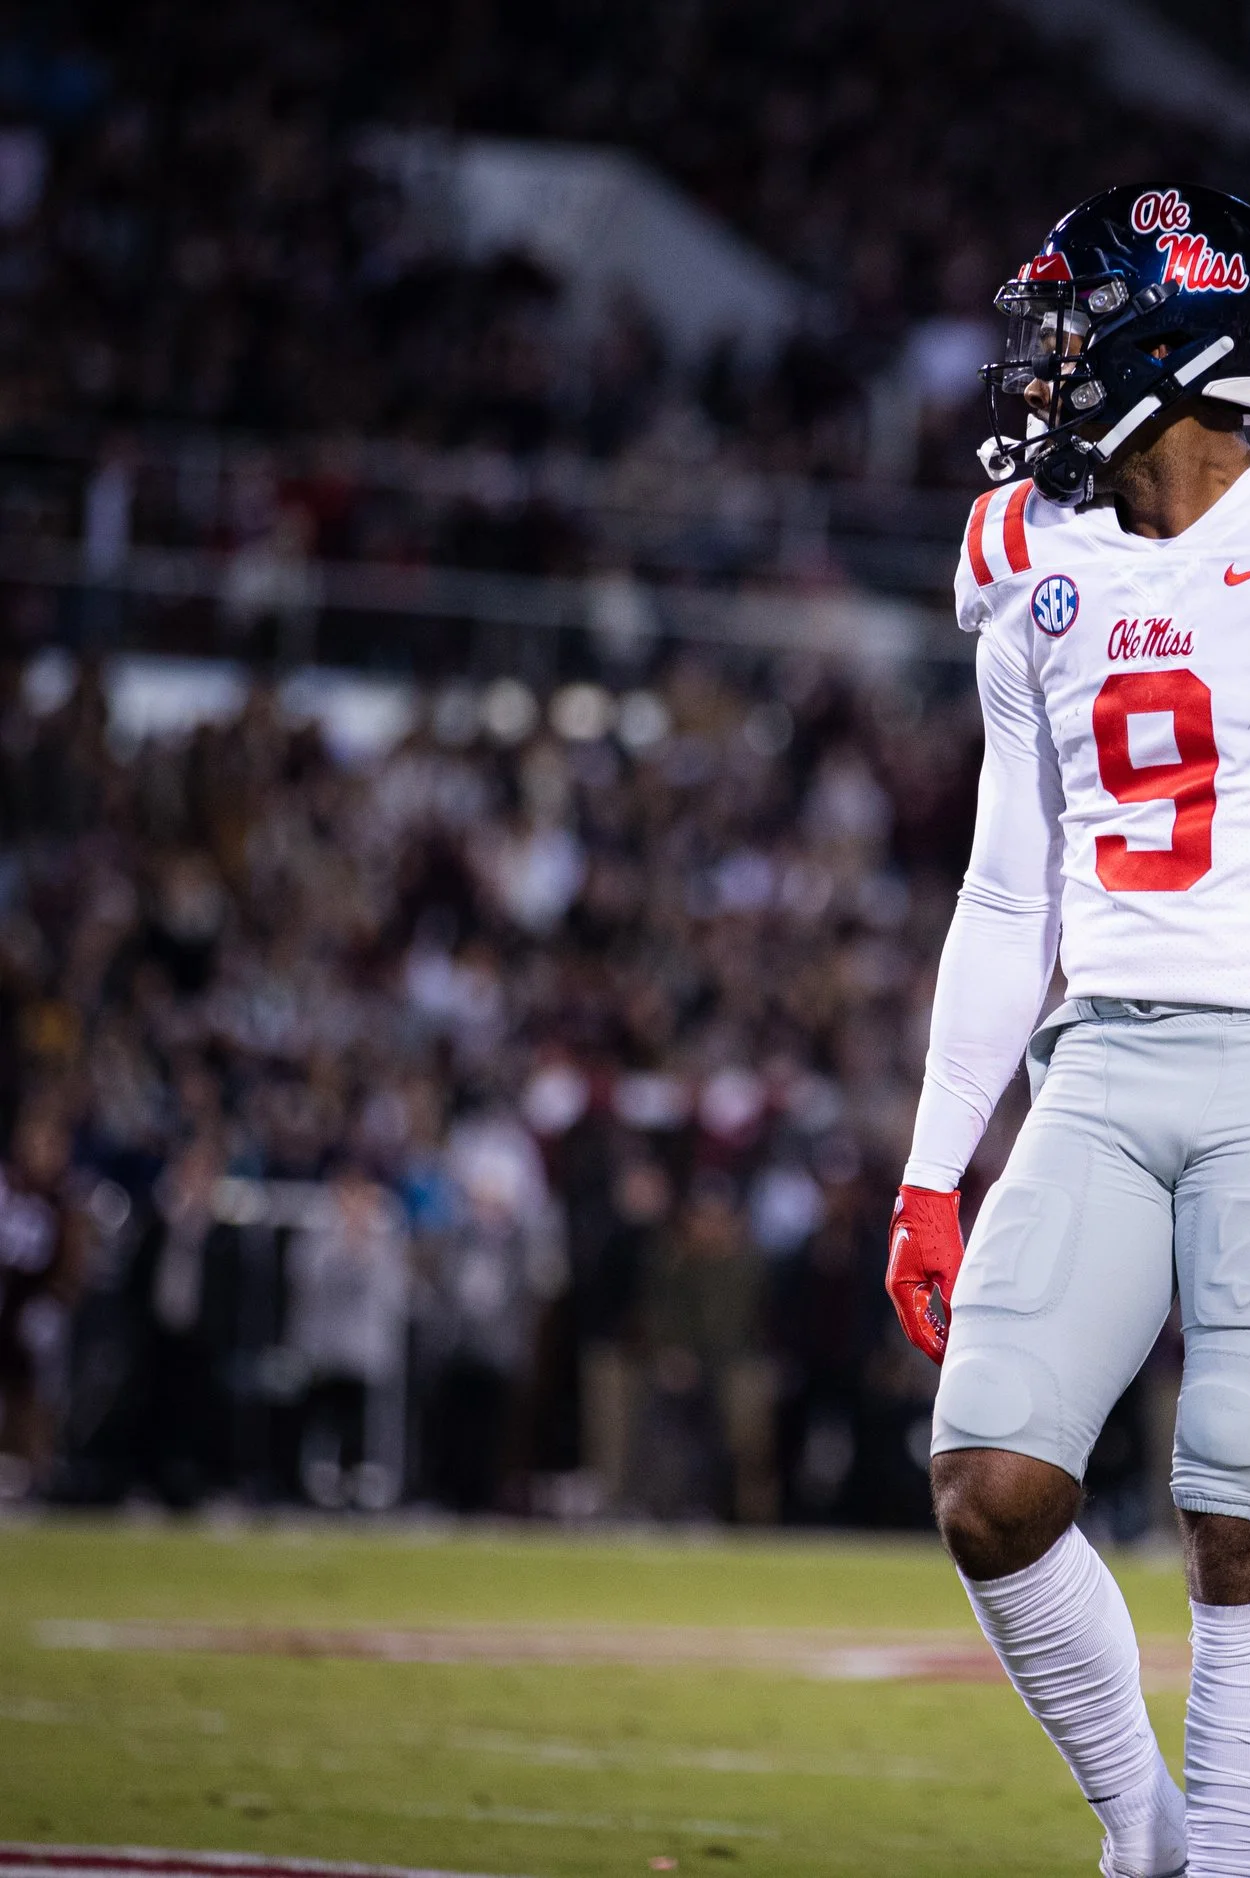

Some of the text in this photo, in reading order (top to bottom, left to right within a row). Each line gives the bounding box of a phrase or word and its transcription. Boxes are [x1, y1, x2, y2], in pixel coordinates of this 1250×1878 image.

[1131, 189, 1190, 234] Ole
[1156, 232, 1250, 293] Miss
[1035, 578, 1075, 632] SEC
[1107, 617, 1194, 661] Ole Miss
[1092, 668, 1219, 892] 9
